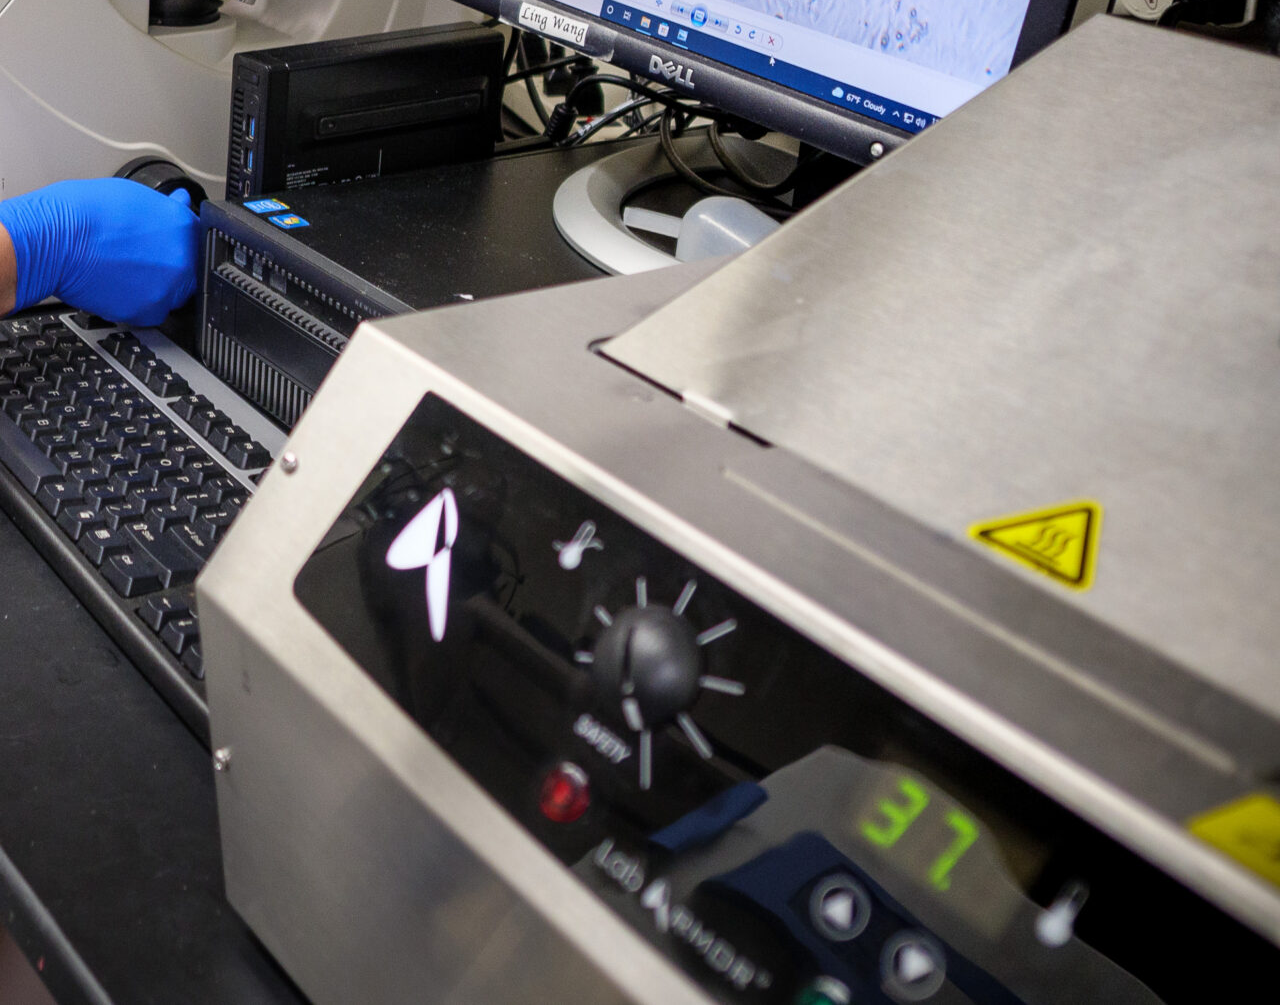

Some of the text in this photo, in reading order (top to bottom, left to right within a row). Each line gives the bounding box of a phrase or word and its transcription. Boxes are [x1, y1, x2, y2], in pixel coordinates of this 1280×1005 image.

[521, 7, 585, 43] Ling Wang
[648, 54, 695, 90] DELL
[846, 93, 886, 116] 67°F Cloudy
[124, 426, 137, 434] U
[573, 712, 632, 764] SAFETY
[858, 776, 980, 891] 37
